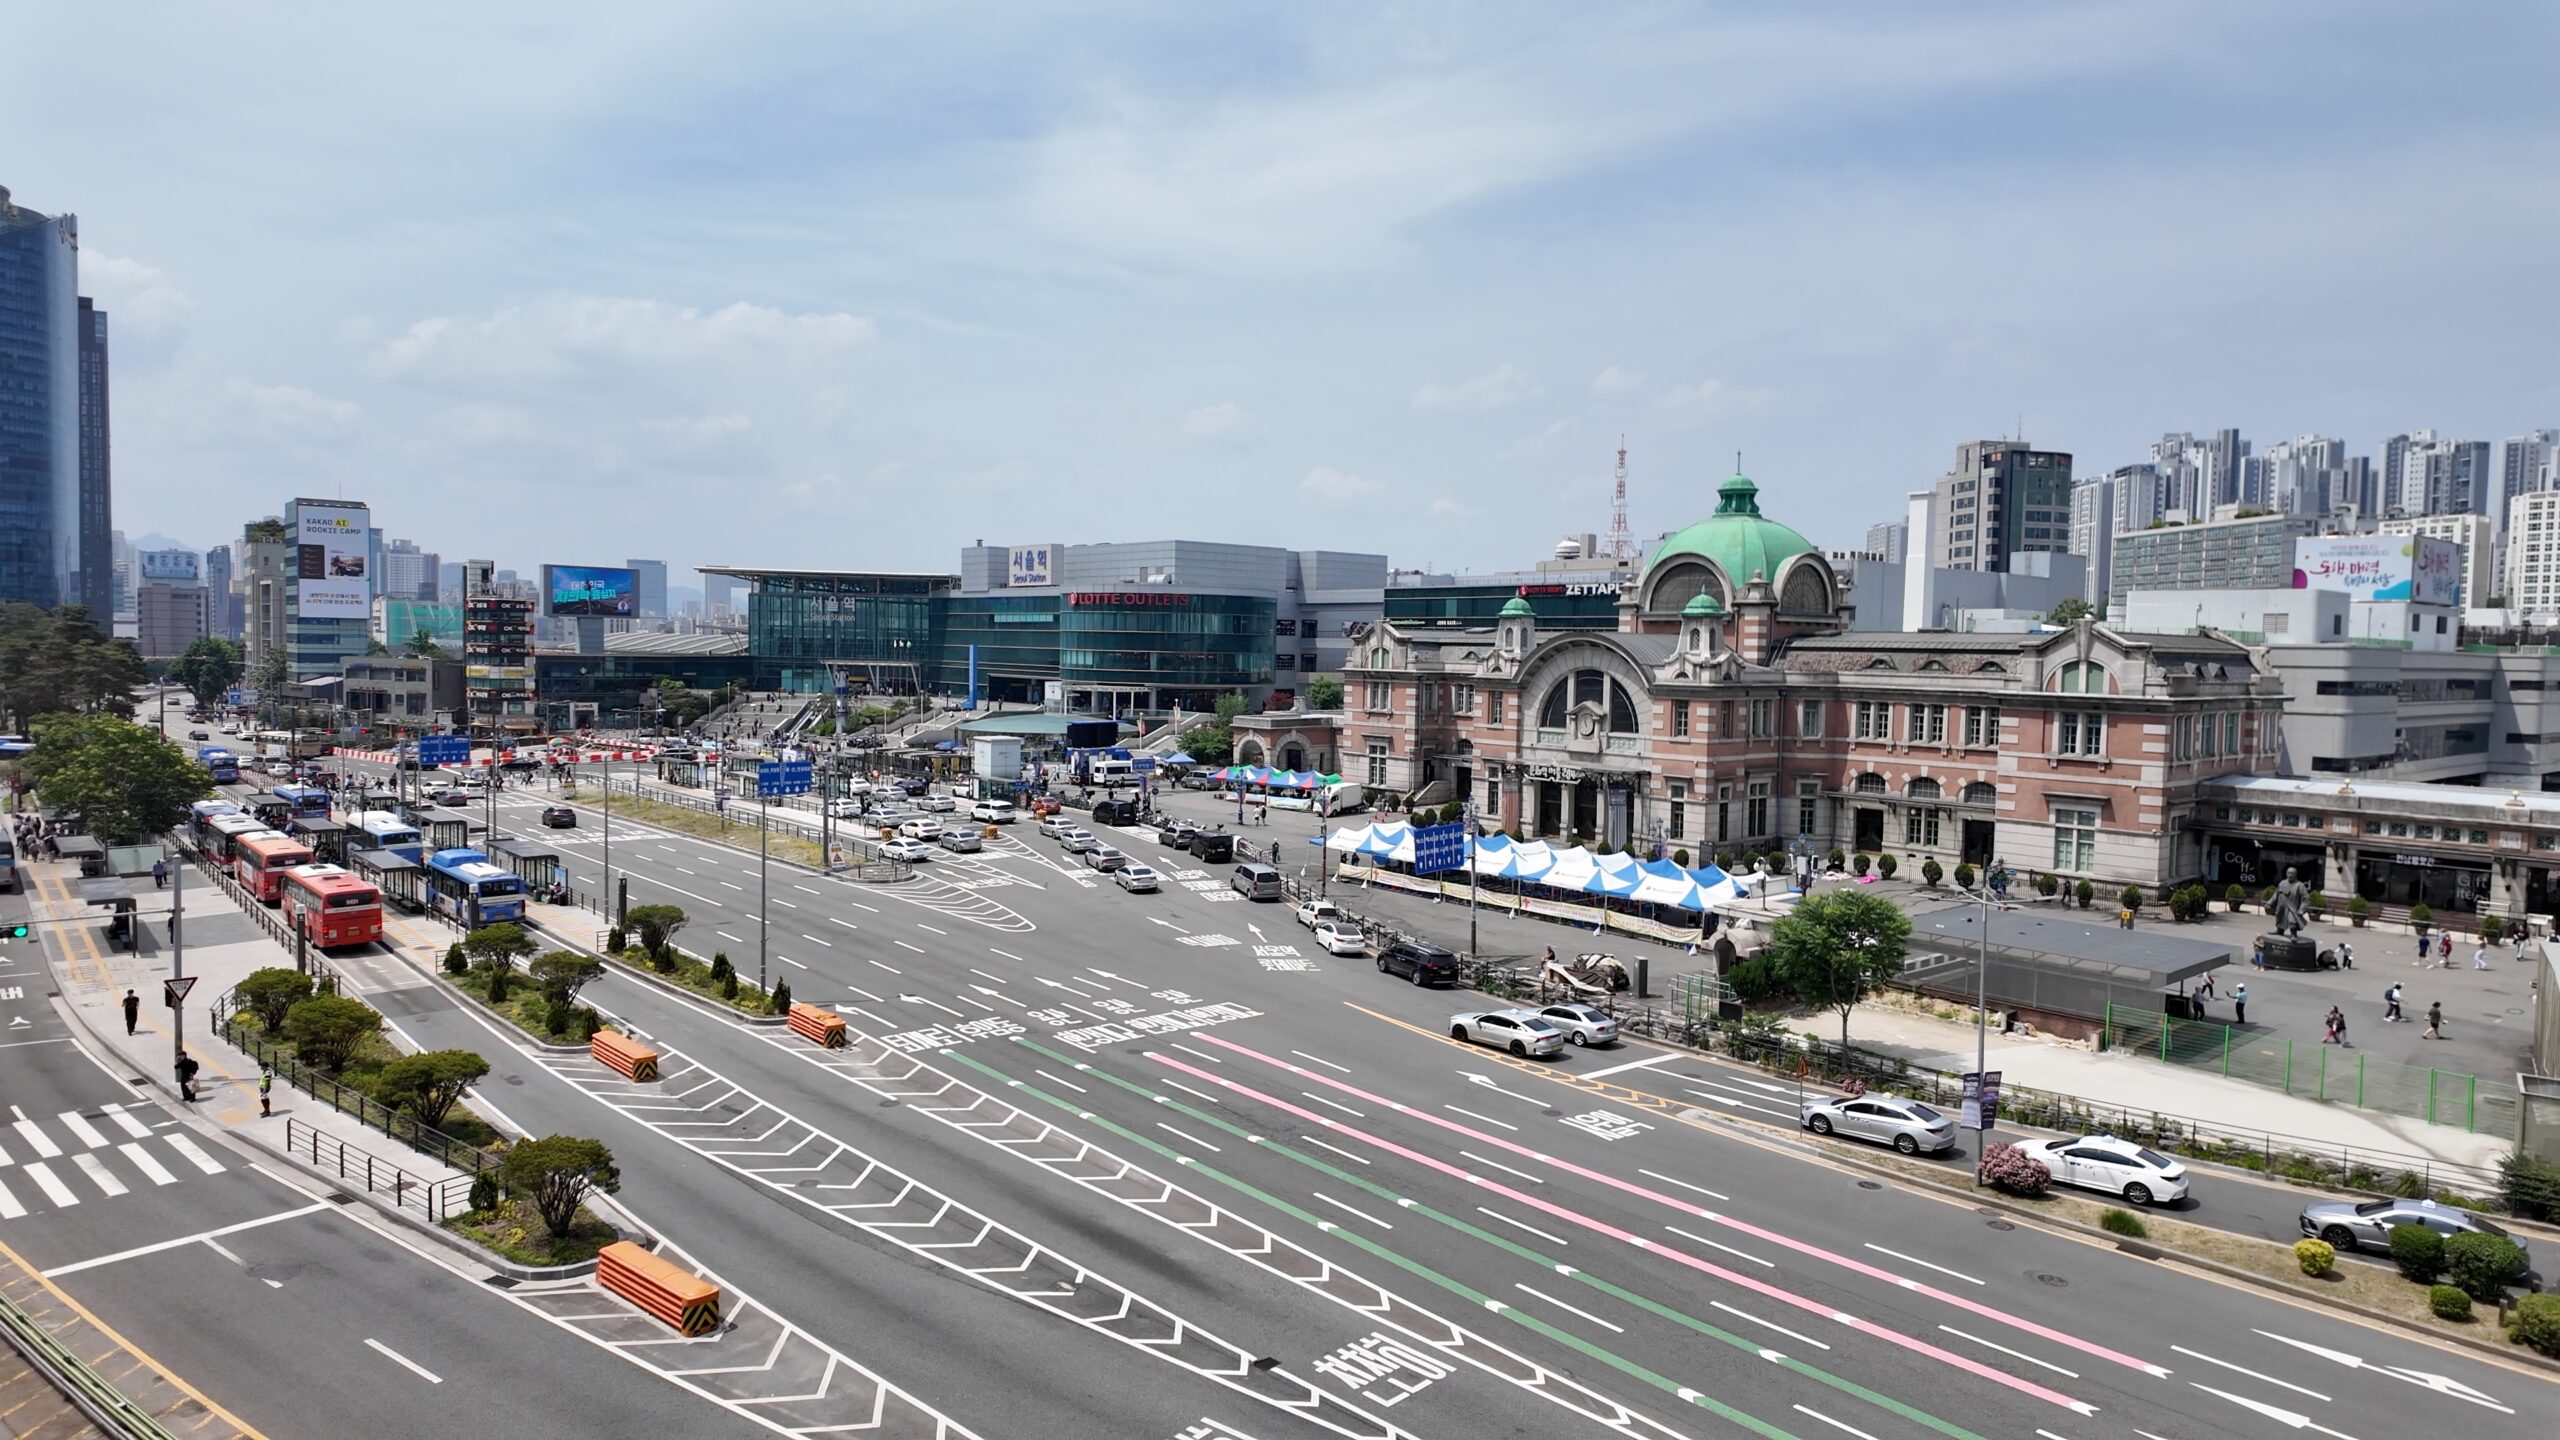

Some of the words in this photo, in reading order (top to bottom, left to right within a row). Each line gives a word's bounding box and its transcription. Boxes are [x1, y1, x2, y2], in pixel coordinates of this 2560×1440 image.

[306, 518, 333, 526] KAKAO
[306, 526, 338, 534] ROOKIE
[1013, 549, 1047, 572] 서울역
[1013, 573, 1028, 584] Seoul
[1028, 573, 1047, 583] Station
[810, 595, 856, 612] 서울역
[1079, 593, 1121, 605] LOTTE
[1124, 594, 1189, 606] OUTLETS
[831, 613, 856, 621] Station
[1252, 945, 1301, 957] 서울역
[1151, 989, 1204, 1005] 용산
[1092, 998, 1146, 1015] 용산
[1026, 1008, 1083, 1026] 용산
[954, 1016, 1027, 1039] 후암동
[880, 1027, 963, 1053] 퇴계로
[1558, 1109, 1656, 1142] 서울역
[1312, 1332, 1458, 1408] 천천히
